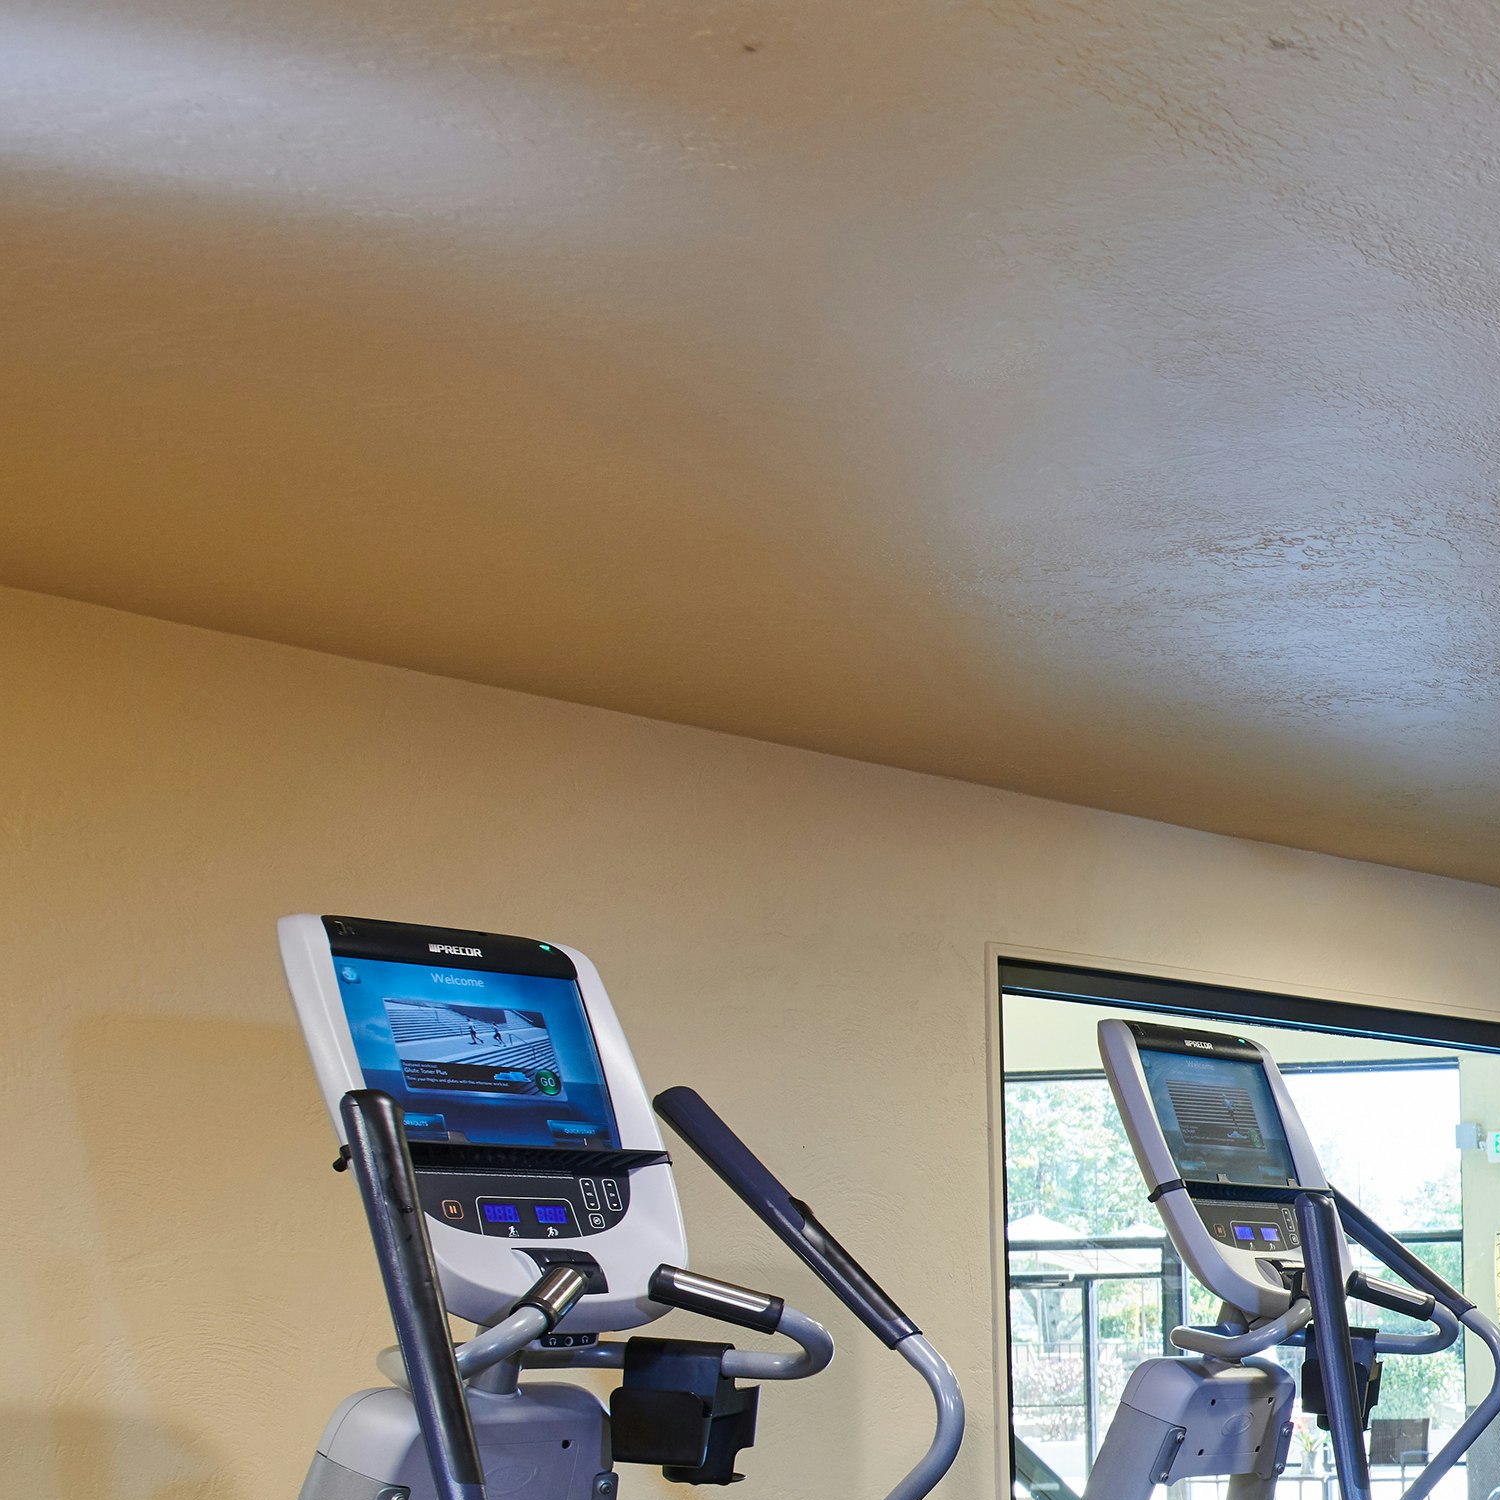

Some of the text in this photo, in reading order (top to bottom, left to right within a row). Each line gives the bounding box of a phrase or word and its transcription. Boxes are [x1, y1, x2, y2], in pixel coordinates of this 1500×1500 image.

[435, 944, 484, 958] PRECOR
[431, 972, 485, 988] Welcome
[540, 1078, 555, 1087] GO
